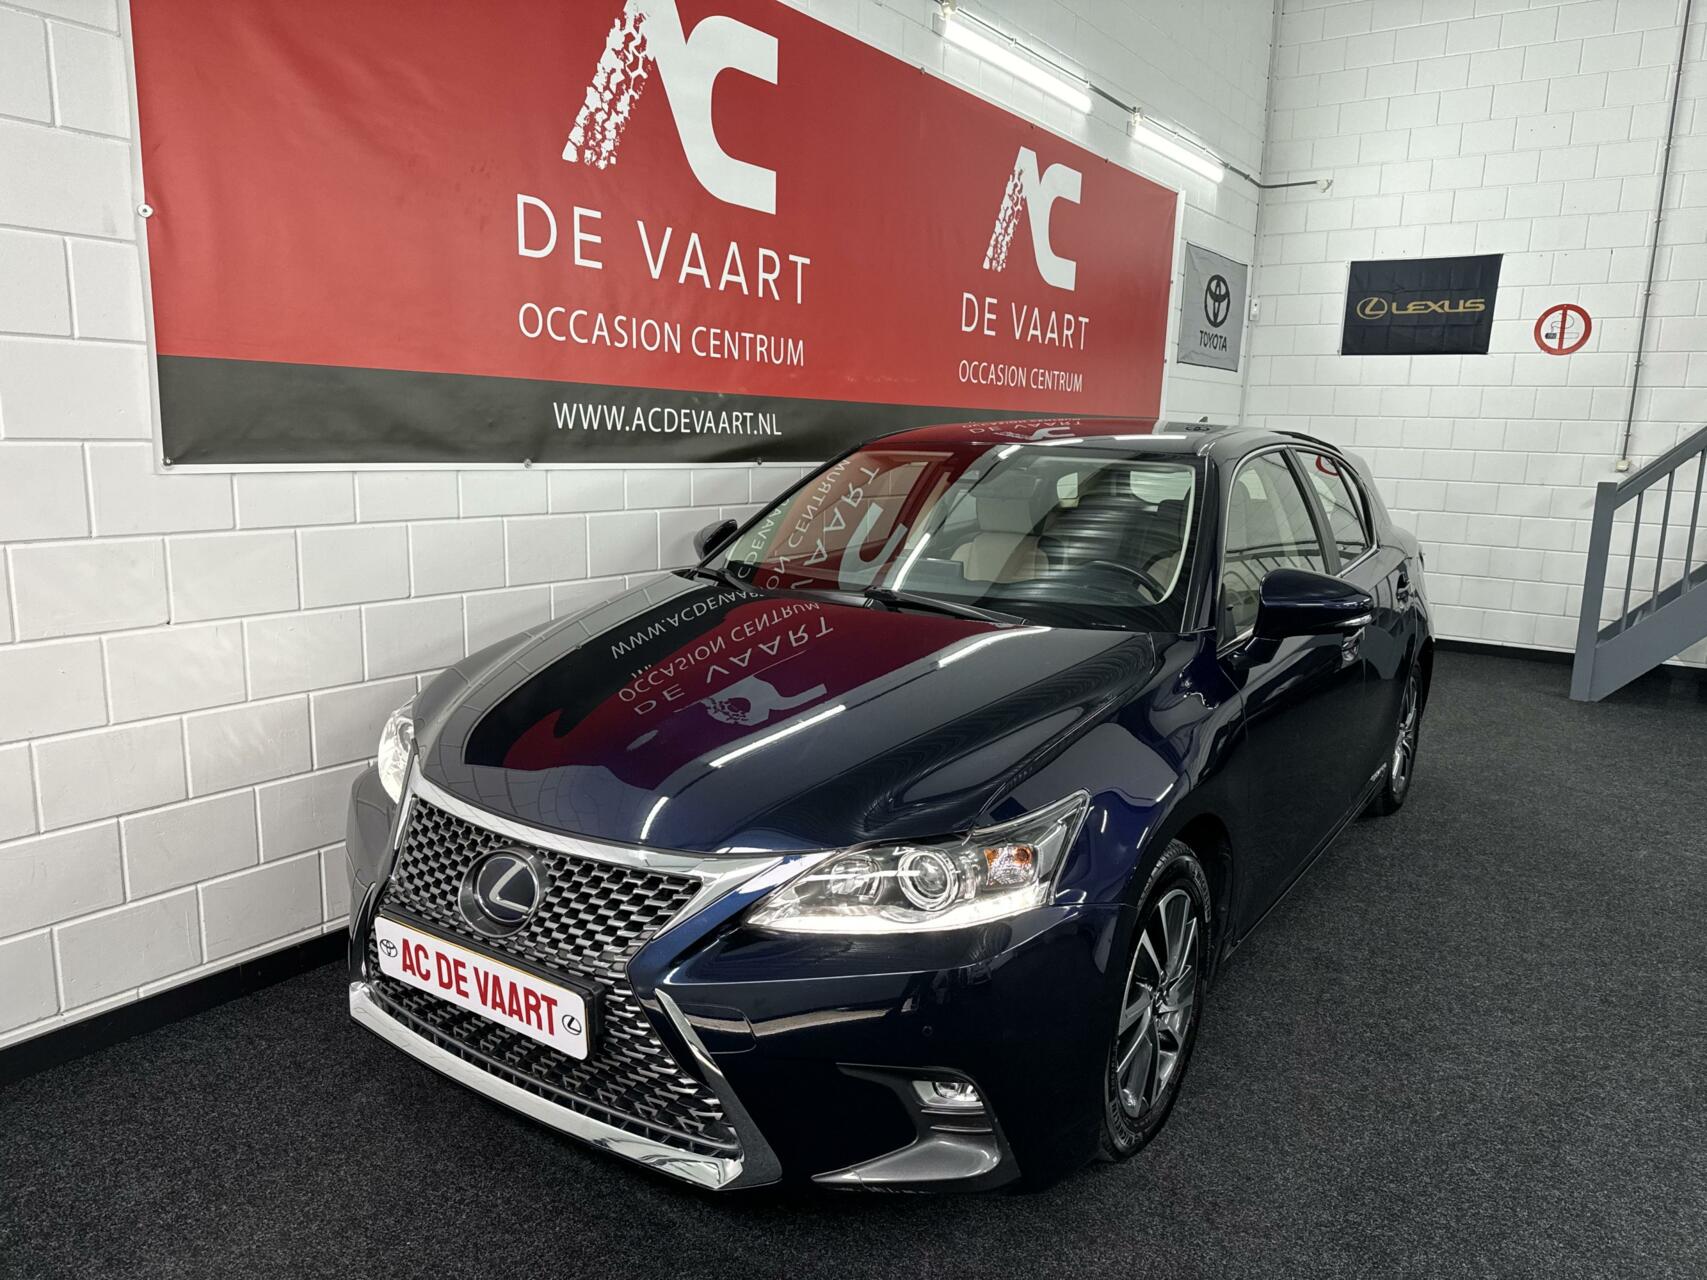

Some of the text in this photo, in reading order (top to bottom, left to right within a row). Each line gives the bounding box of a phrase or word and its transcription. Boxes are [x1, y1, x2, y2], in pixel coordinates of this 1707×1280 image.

[517, 193, 811, 304] DE VAART
[961, 292, 1090, 350] DE VAART
[1391, 298, 1486, 314] LEXUS
[518, 302, 805, 367] OCCASION CENTRUM
[1199, 329, 1228, 353] TOYOTA
[958, 359, 1083, 393] OCCASION CENTRUM
[553, 402, 782, 435] WWW.ACDEVAART.NL
[401, 938, 431, 982] AC
[435, 951, 470, 999] DE
[473, 966, 558, 1036] VAART
